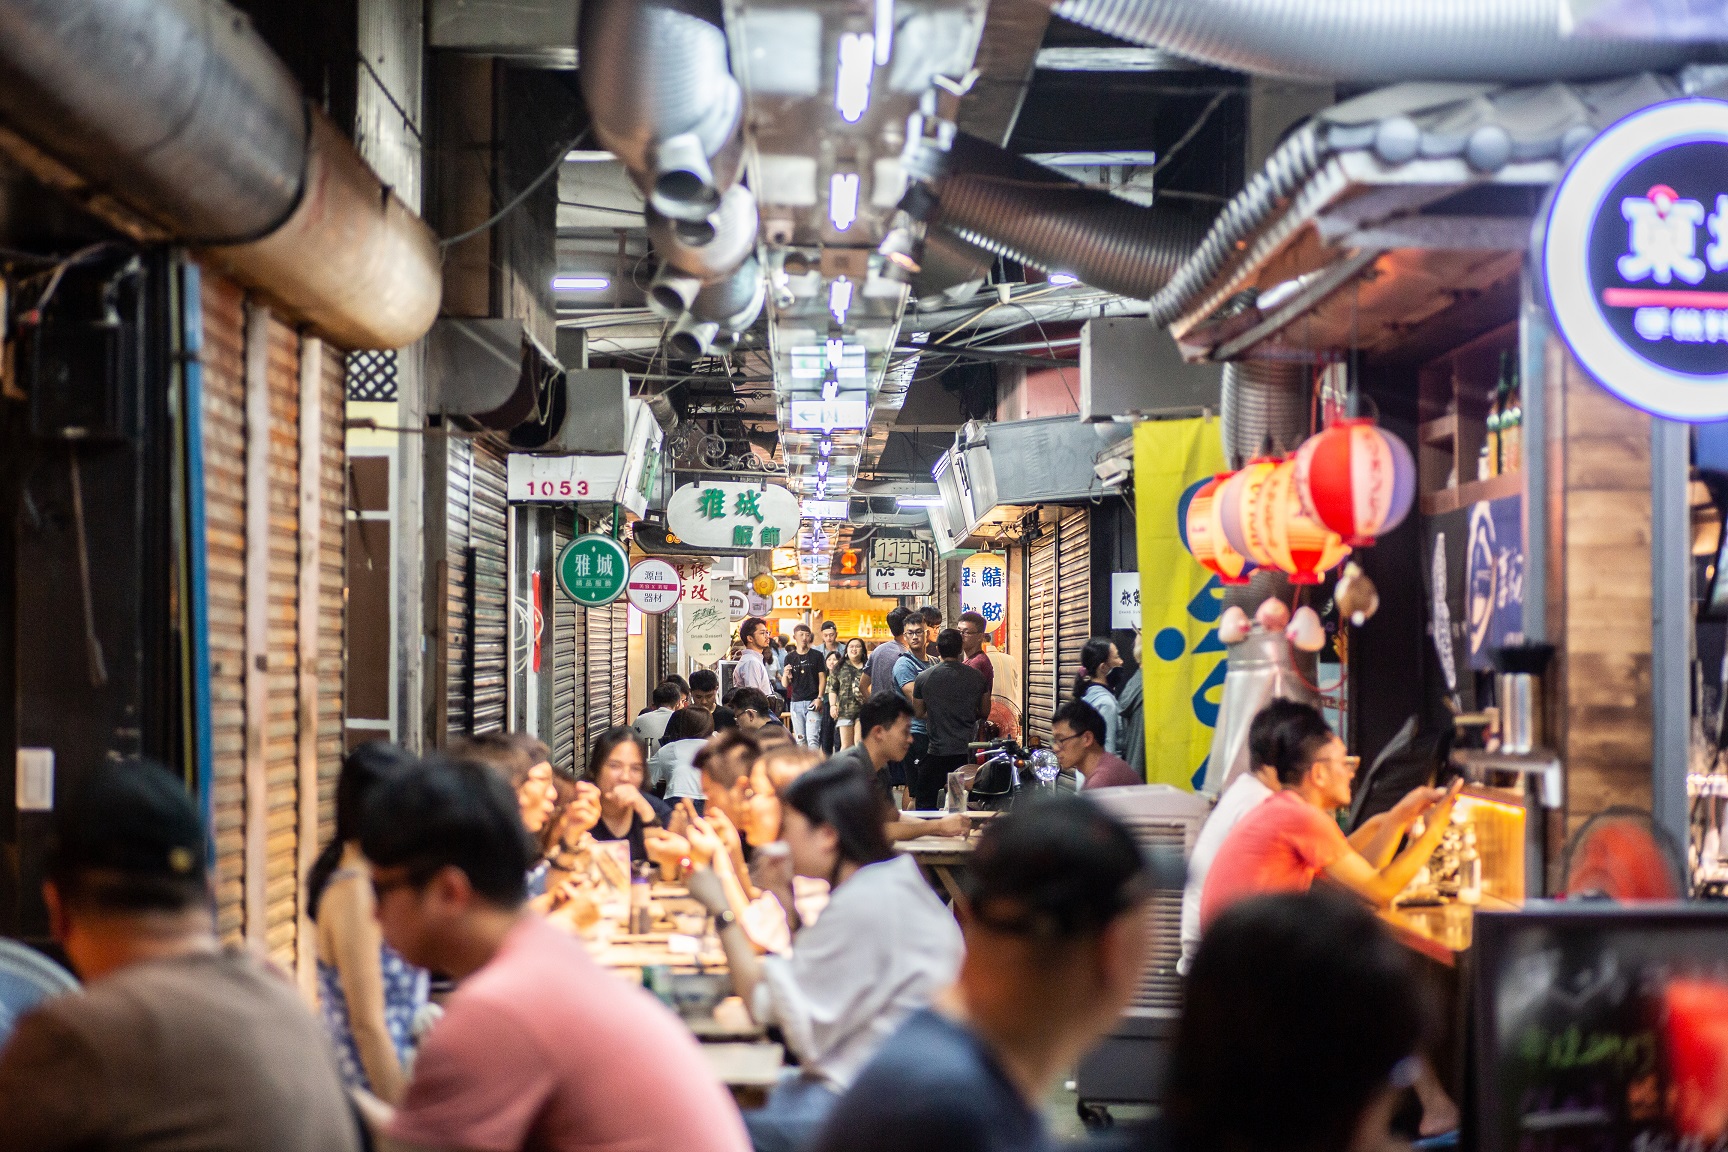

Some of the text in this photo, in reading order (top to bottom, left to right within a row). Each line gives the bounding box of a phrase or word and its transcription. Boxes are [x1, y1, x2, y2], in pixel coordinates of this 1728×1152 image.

[526, 480, 589, 496] 1053
[697, 488, 764, 522] 雅城
[733, 524, 781, 547] 服飾
[876, 541, 921, 566] 1132
[574, 553, 613, 577] 雅城
[981, 566, 1002, 587] 鯖
[644, 592, 663, 603] 器材
[777, 594, 811, 607] 1012
